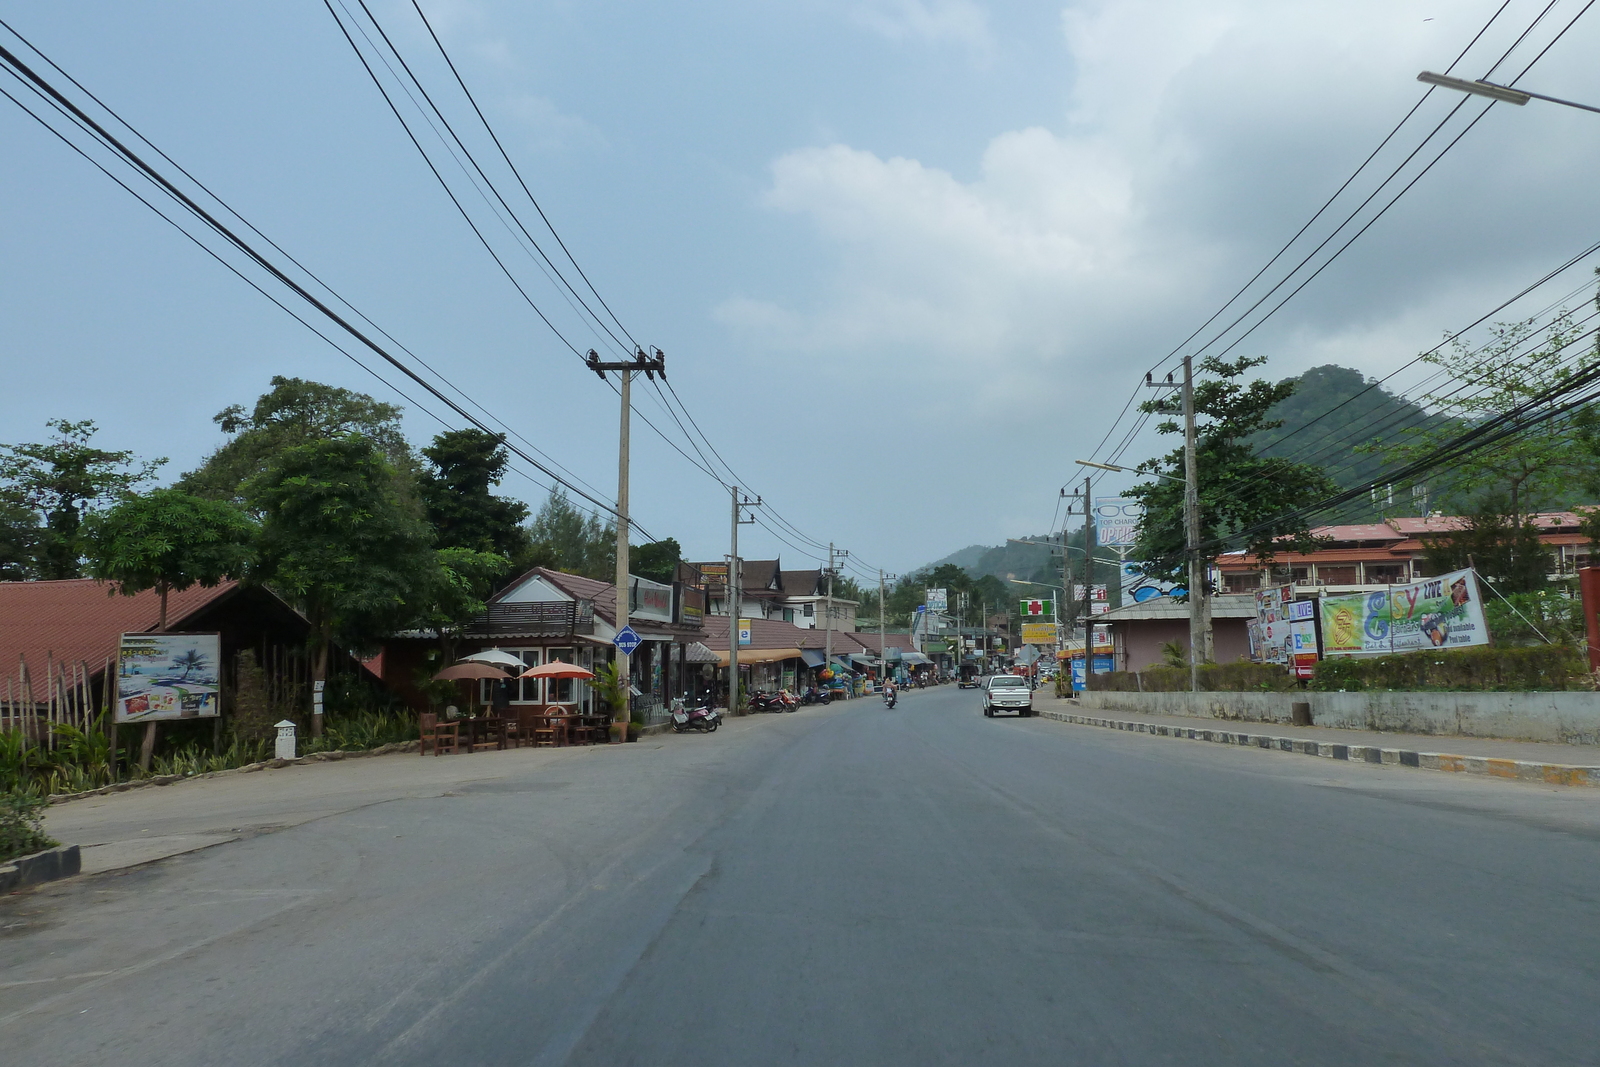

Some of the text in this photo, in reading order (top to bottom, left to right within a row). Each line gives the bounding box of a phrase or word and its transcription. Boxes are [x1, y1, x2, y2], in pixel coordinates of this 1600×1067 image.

[1100, 527, 1142, 544] OPTIC
[1424, 580, 1442, 600] LIVE
[1297, 604, 1312, 618] LIVE
